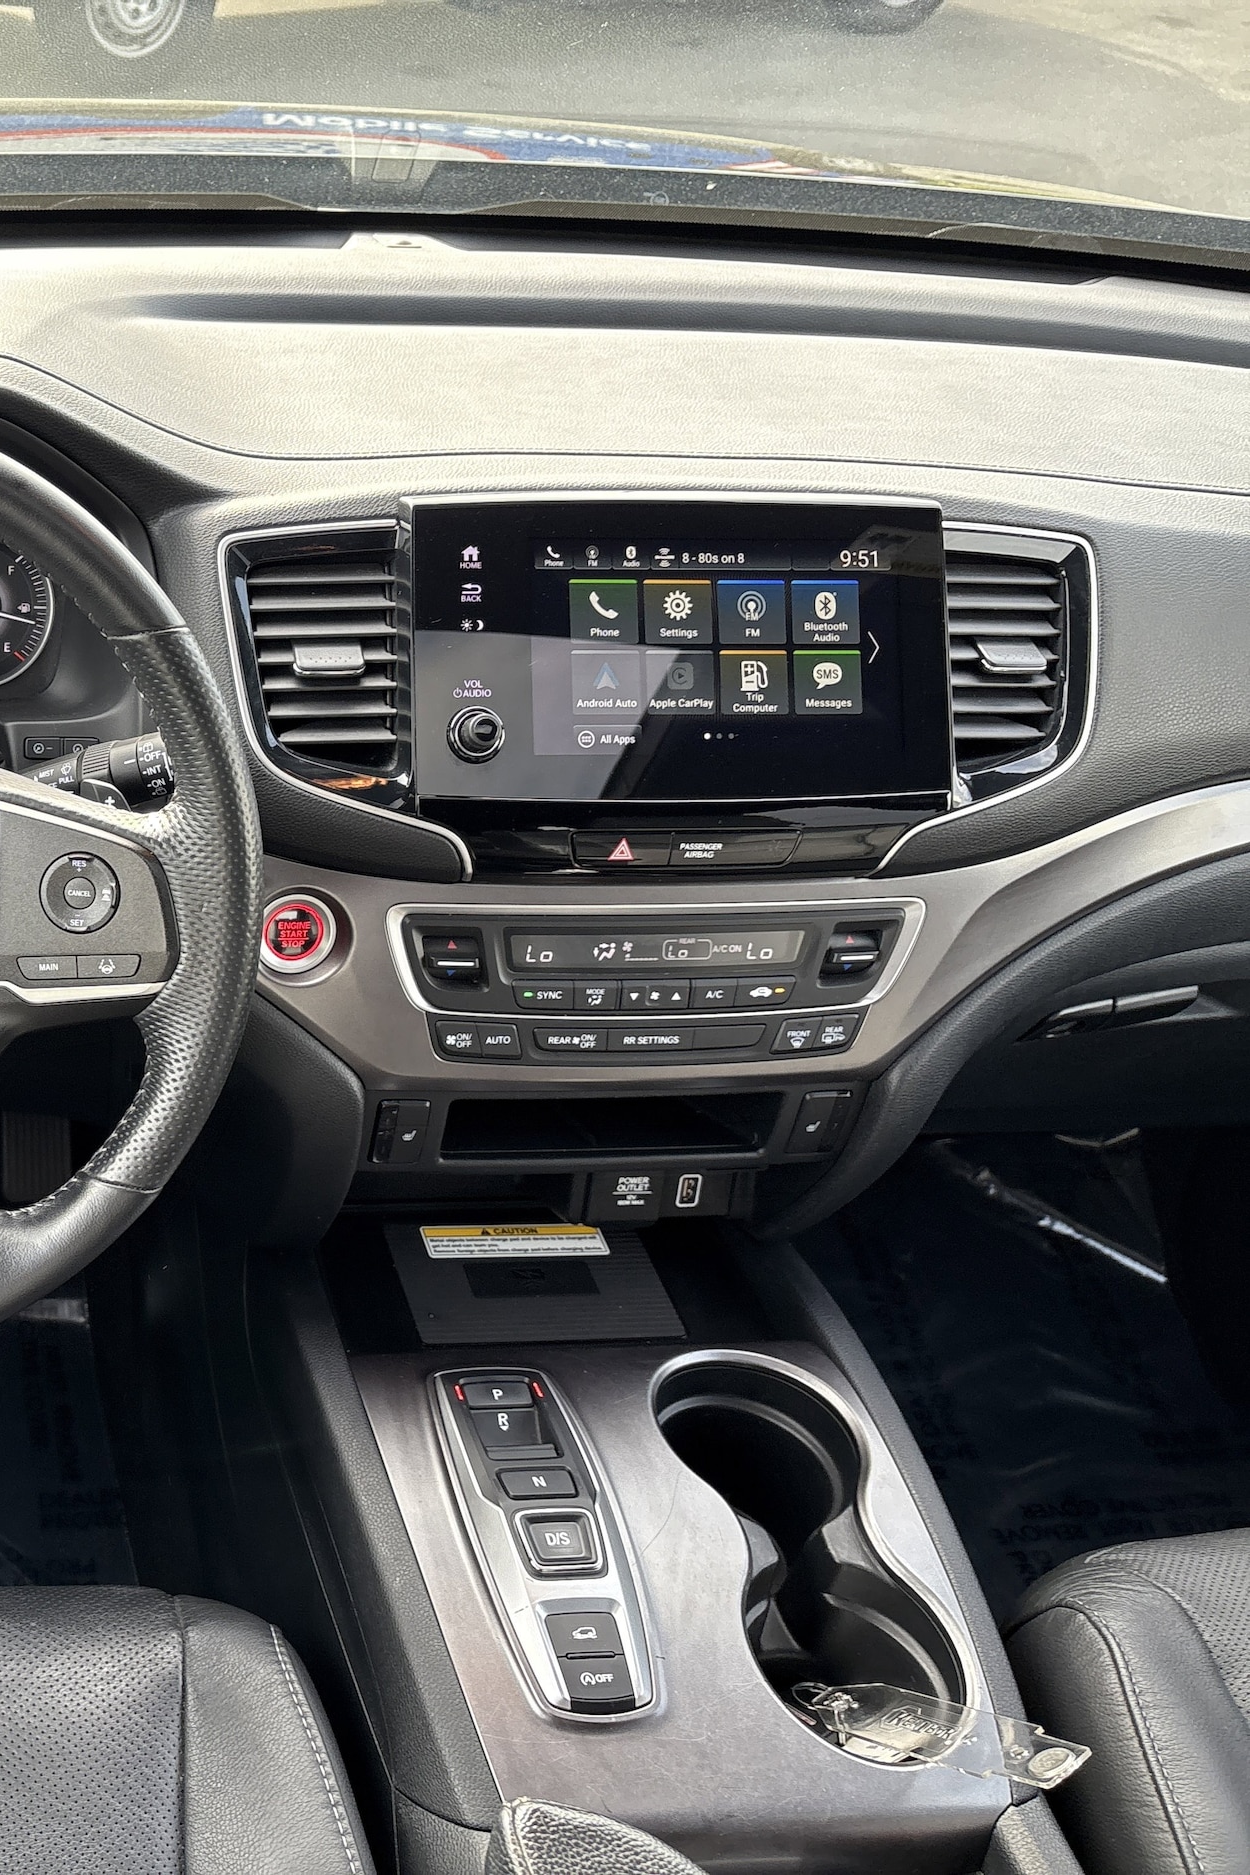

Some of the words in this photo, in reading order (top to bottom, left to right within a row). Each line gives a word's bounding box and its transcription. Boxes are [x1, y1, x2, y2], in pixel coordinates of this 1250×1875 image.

[544, 559, 564, 568] Phone
[587, 559, 598, 567] FM
[622, 559, 640, 568] Audio
[682, 553, 690, 564] 8
[698, 553, 719, 564] 80s
[721, 555, 735, 564] on
[737, 553, 745, 564] 8
[839, 550, 880, 568] 9:51
[8, 565, 15, 575] F
[804, 621, 849, 632] Bluetooth
[590, 627, 620, 638] Phone
[659, 627, 699, 640] Settings
[745, 628, 760, 638] FM
[813, 632, 841, 643] Audio
[4, 642, 11, 653] E
[816, 669, 839, 680] SMS
[464, 680, 483, 688] VOL
[463, 689, 492, 698] AUDIO
[746, 692, 764, 703] Trip
[576, 698, 616, 708] Android
[618, 699, 637, 708] Auto
[649, 699, 676, 710] Apple
[678, 699, 713, 710] CarPlay
[805, 698, 852, 710] Messages
[733, 703, 778, 714] Computer
[600, 735, 614, 744] All
[617, 735, 636, 746] Apps
[144, 750, 162, 762] OFF
[39, 769, 54, 778] MIST
[146, 764, 162, 775] INT
[58, 775, 75, 784] PULL
[151, 778, 167, 789] ON
[67, 889, 92, 897] CANCEL
[70, 919, 84, 927] SET
[278, 921, 311, 930] ENGINE
[280, 930, 308, 938] START
[712, 945, 728, 953] A/C
[729, 944, 742, 953] ON
[39, 963, 59, 971] MAIN
[537, 990, 563, 1000] SYNC
[705, 989, 724, 999] A/C
[456, 1040, 472, 1048] OFF
[485, 1036, 511, 1044] AUTO
[548, 1036, 571, 1044] REAR
[580, 1041, 597, 1049] OFF
[637, 1036, 680, 1044] SETTINGS
[616, 1183, 650, 1191] OUTLET
[493, 1227, 538, 1235] CAUTION
[492, 1388, 503, 1400] P
[497, 1413, 510, 1427] R
[532, 1476, 547, 1488] N
[545, 1531, 571, 1546] D/S
[595, 1673, 614, 1683] OFF
